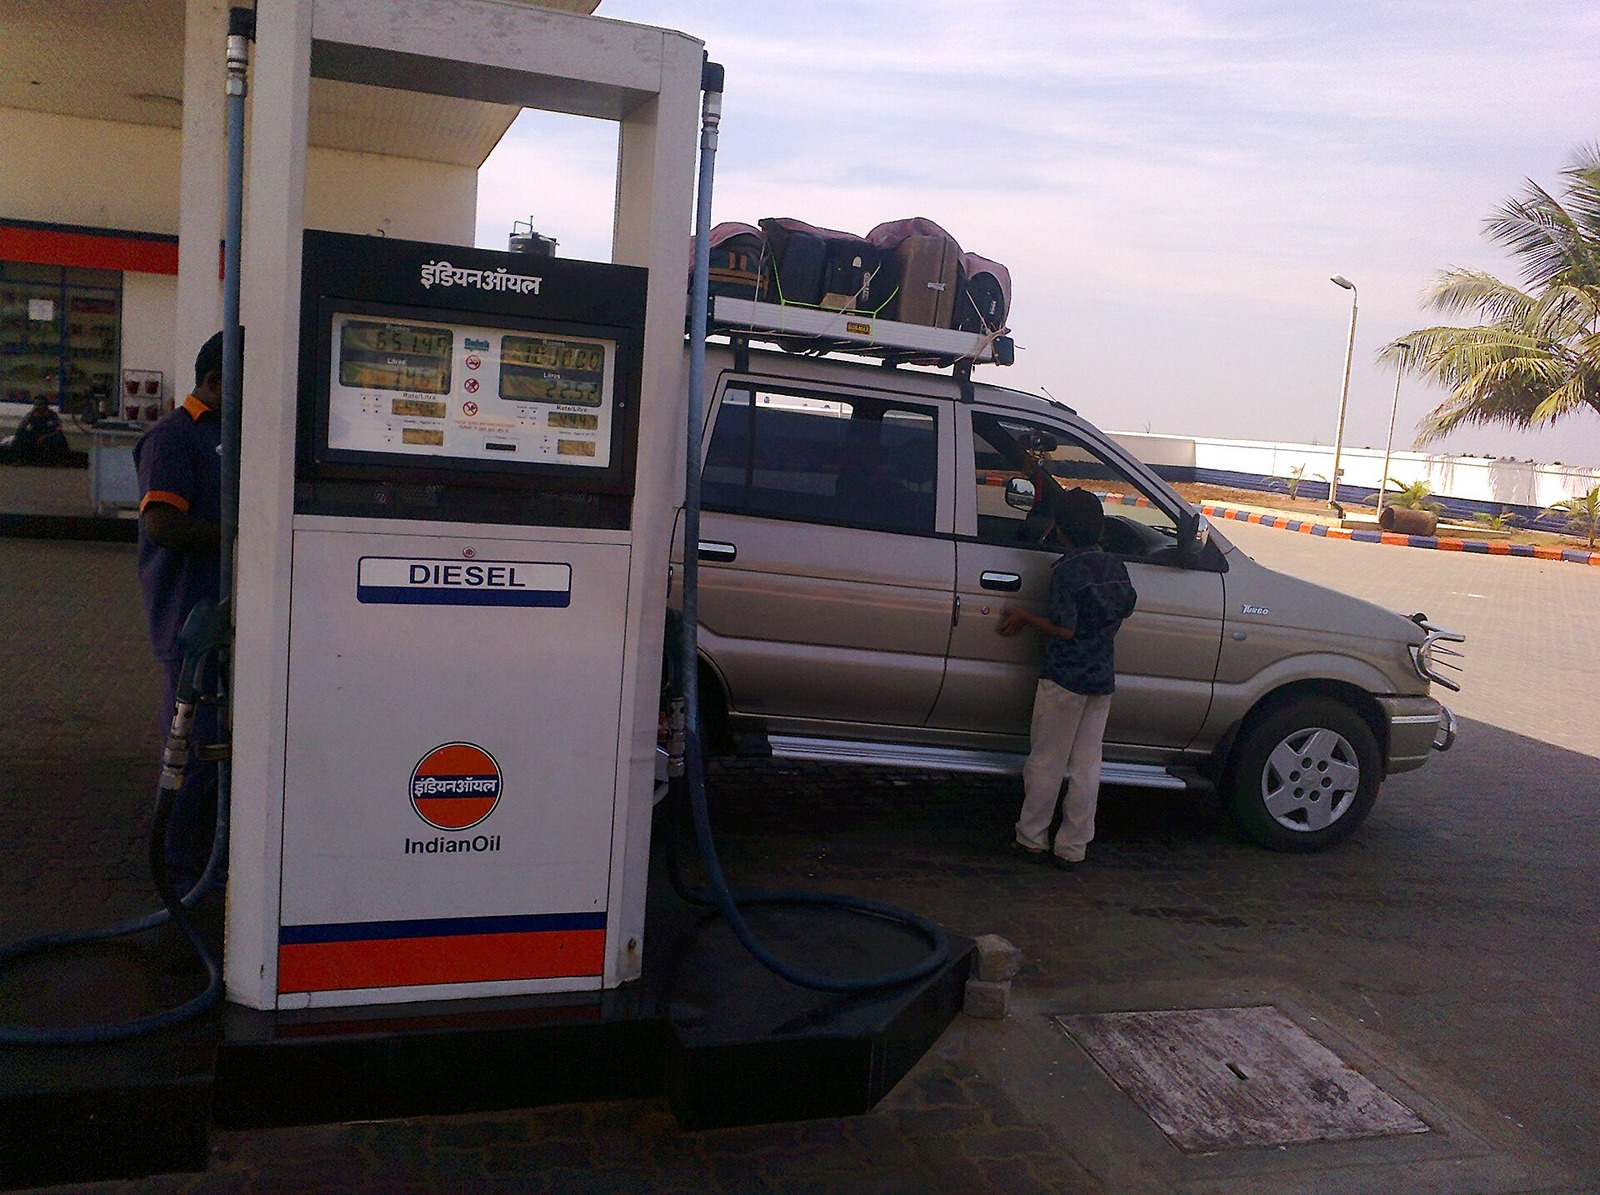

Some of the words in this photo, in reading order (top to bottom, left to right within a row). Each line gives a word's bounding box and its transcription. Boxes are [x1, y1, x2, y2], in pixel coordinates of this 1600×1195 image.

[420, 259, 543, 295] इंडियनऑयल
[409, 564, 526, 587] DIESEL
[414, 777, 498, 797] इंडियनऑयल
[404, 835, 501, 855] IndianOil
